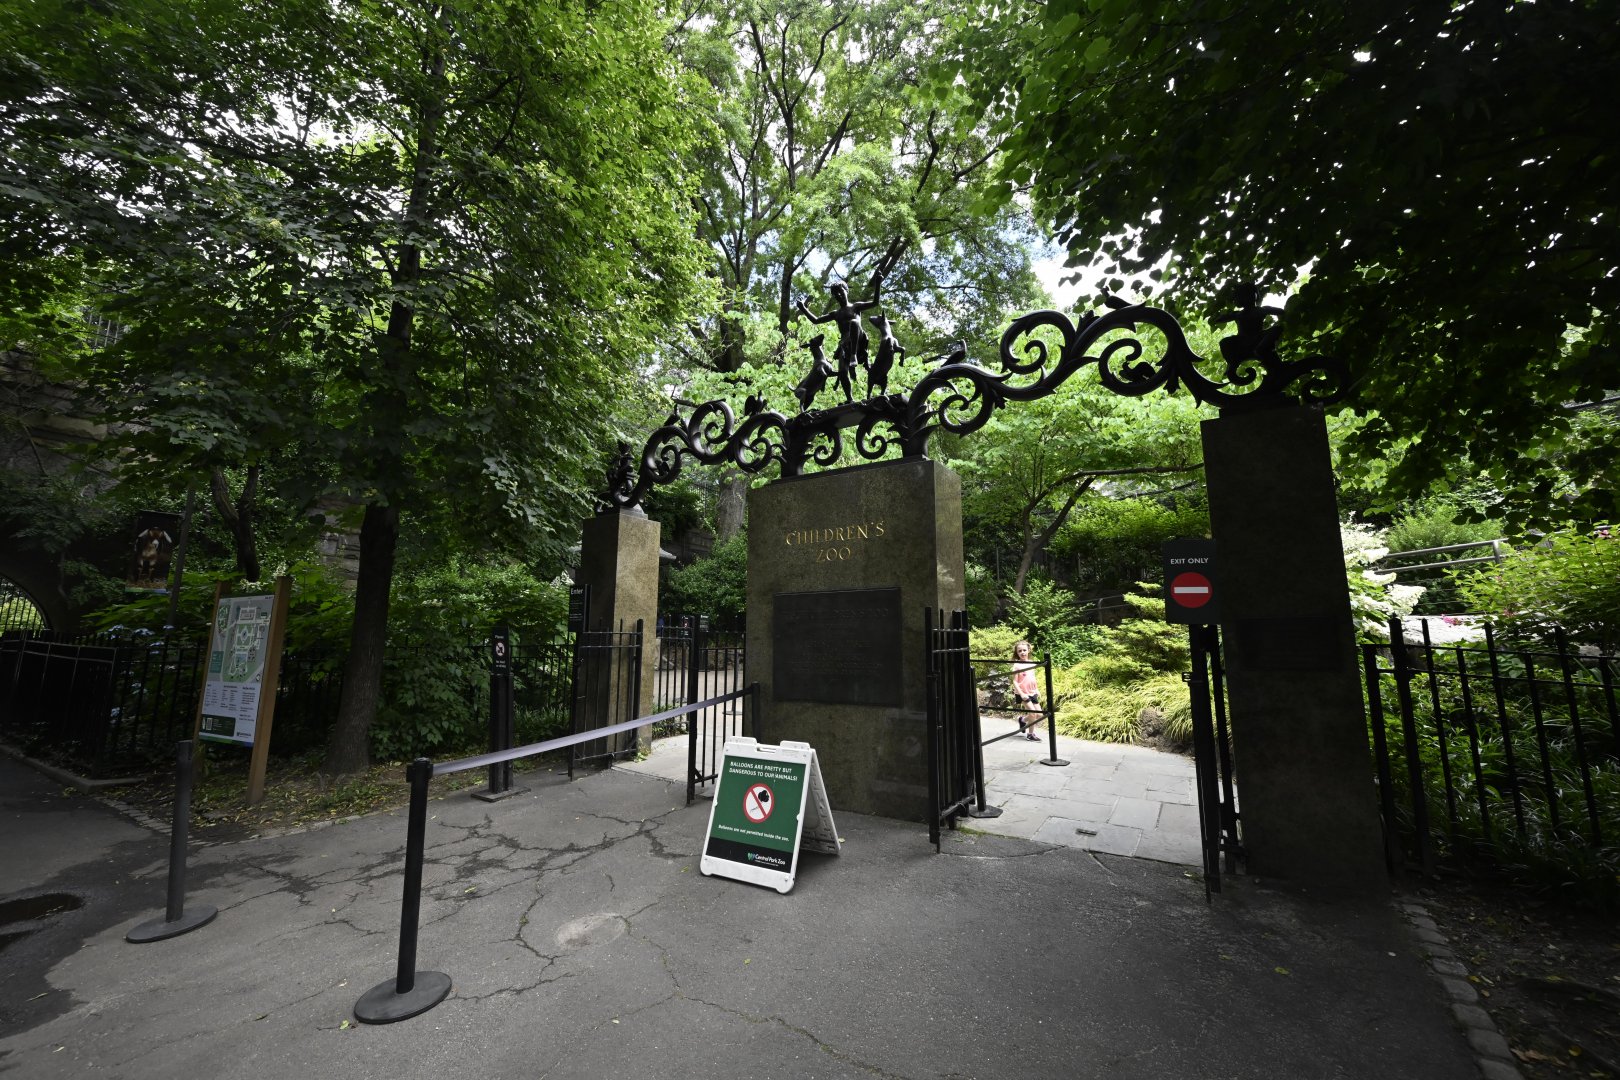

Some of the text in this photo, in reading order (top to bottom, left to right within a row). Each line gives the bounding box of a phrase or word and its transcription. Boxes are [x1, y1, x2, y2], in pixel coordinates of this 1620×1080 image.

[786, 520, 885, 546] CHILDREN'S
[816, 546, 851, 562] ZOO
[730, 761, 754, 769] BALLOONS
[729, 768, 756, 776] DANGEROUS
[774, 774, 798, 782] ANIMALS!
[755, 854, 769, 862] Central
